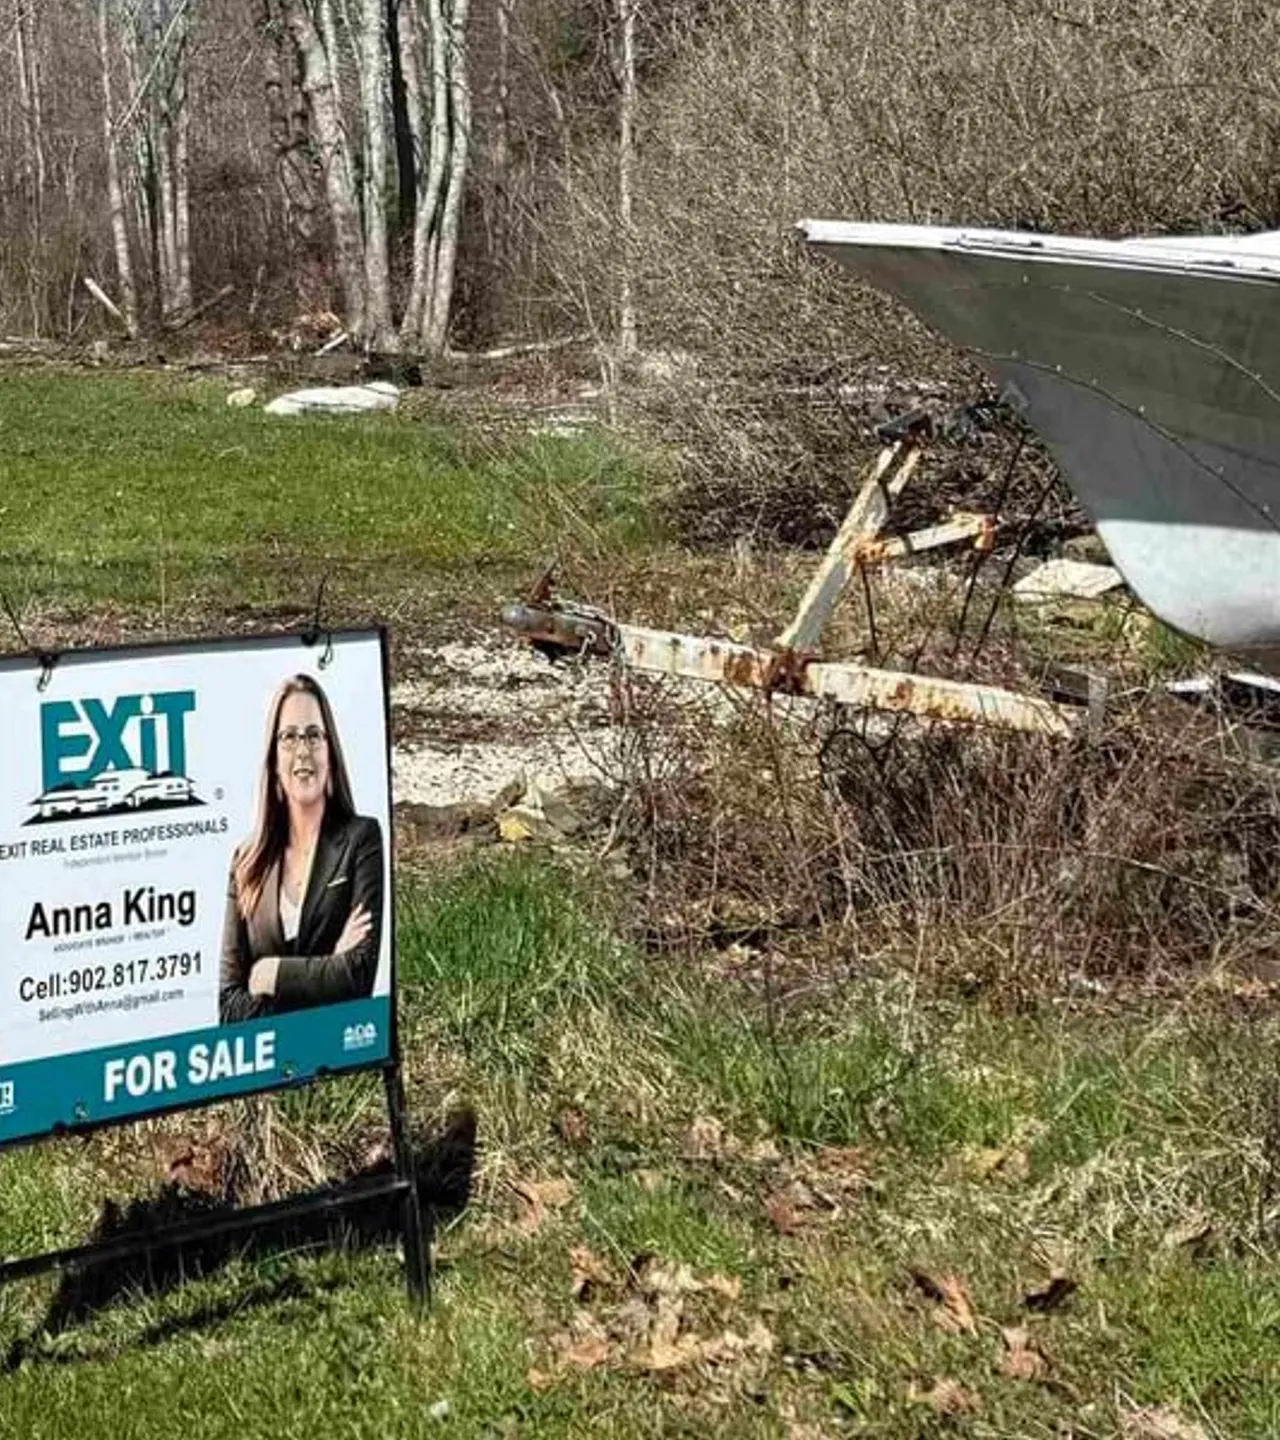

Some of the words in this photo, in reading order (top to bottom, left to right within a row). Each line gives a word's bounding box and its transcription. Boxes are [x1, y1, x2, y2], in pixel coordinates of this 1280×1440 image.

[31, 837, 67, 857] REAL
[70, 830, 120, 852] ESTATE
[122, 817, 229, 845] PROFESSIONALS
[24, 901, 113, 941] Anna
[123, 886, 197, 927] King
[19, 950, 203, 1002] Cell:902.817.3791
[103, 1049, 178, 1103] FOR
[188, 1030, 277, 1085] SALE
